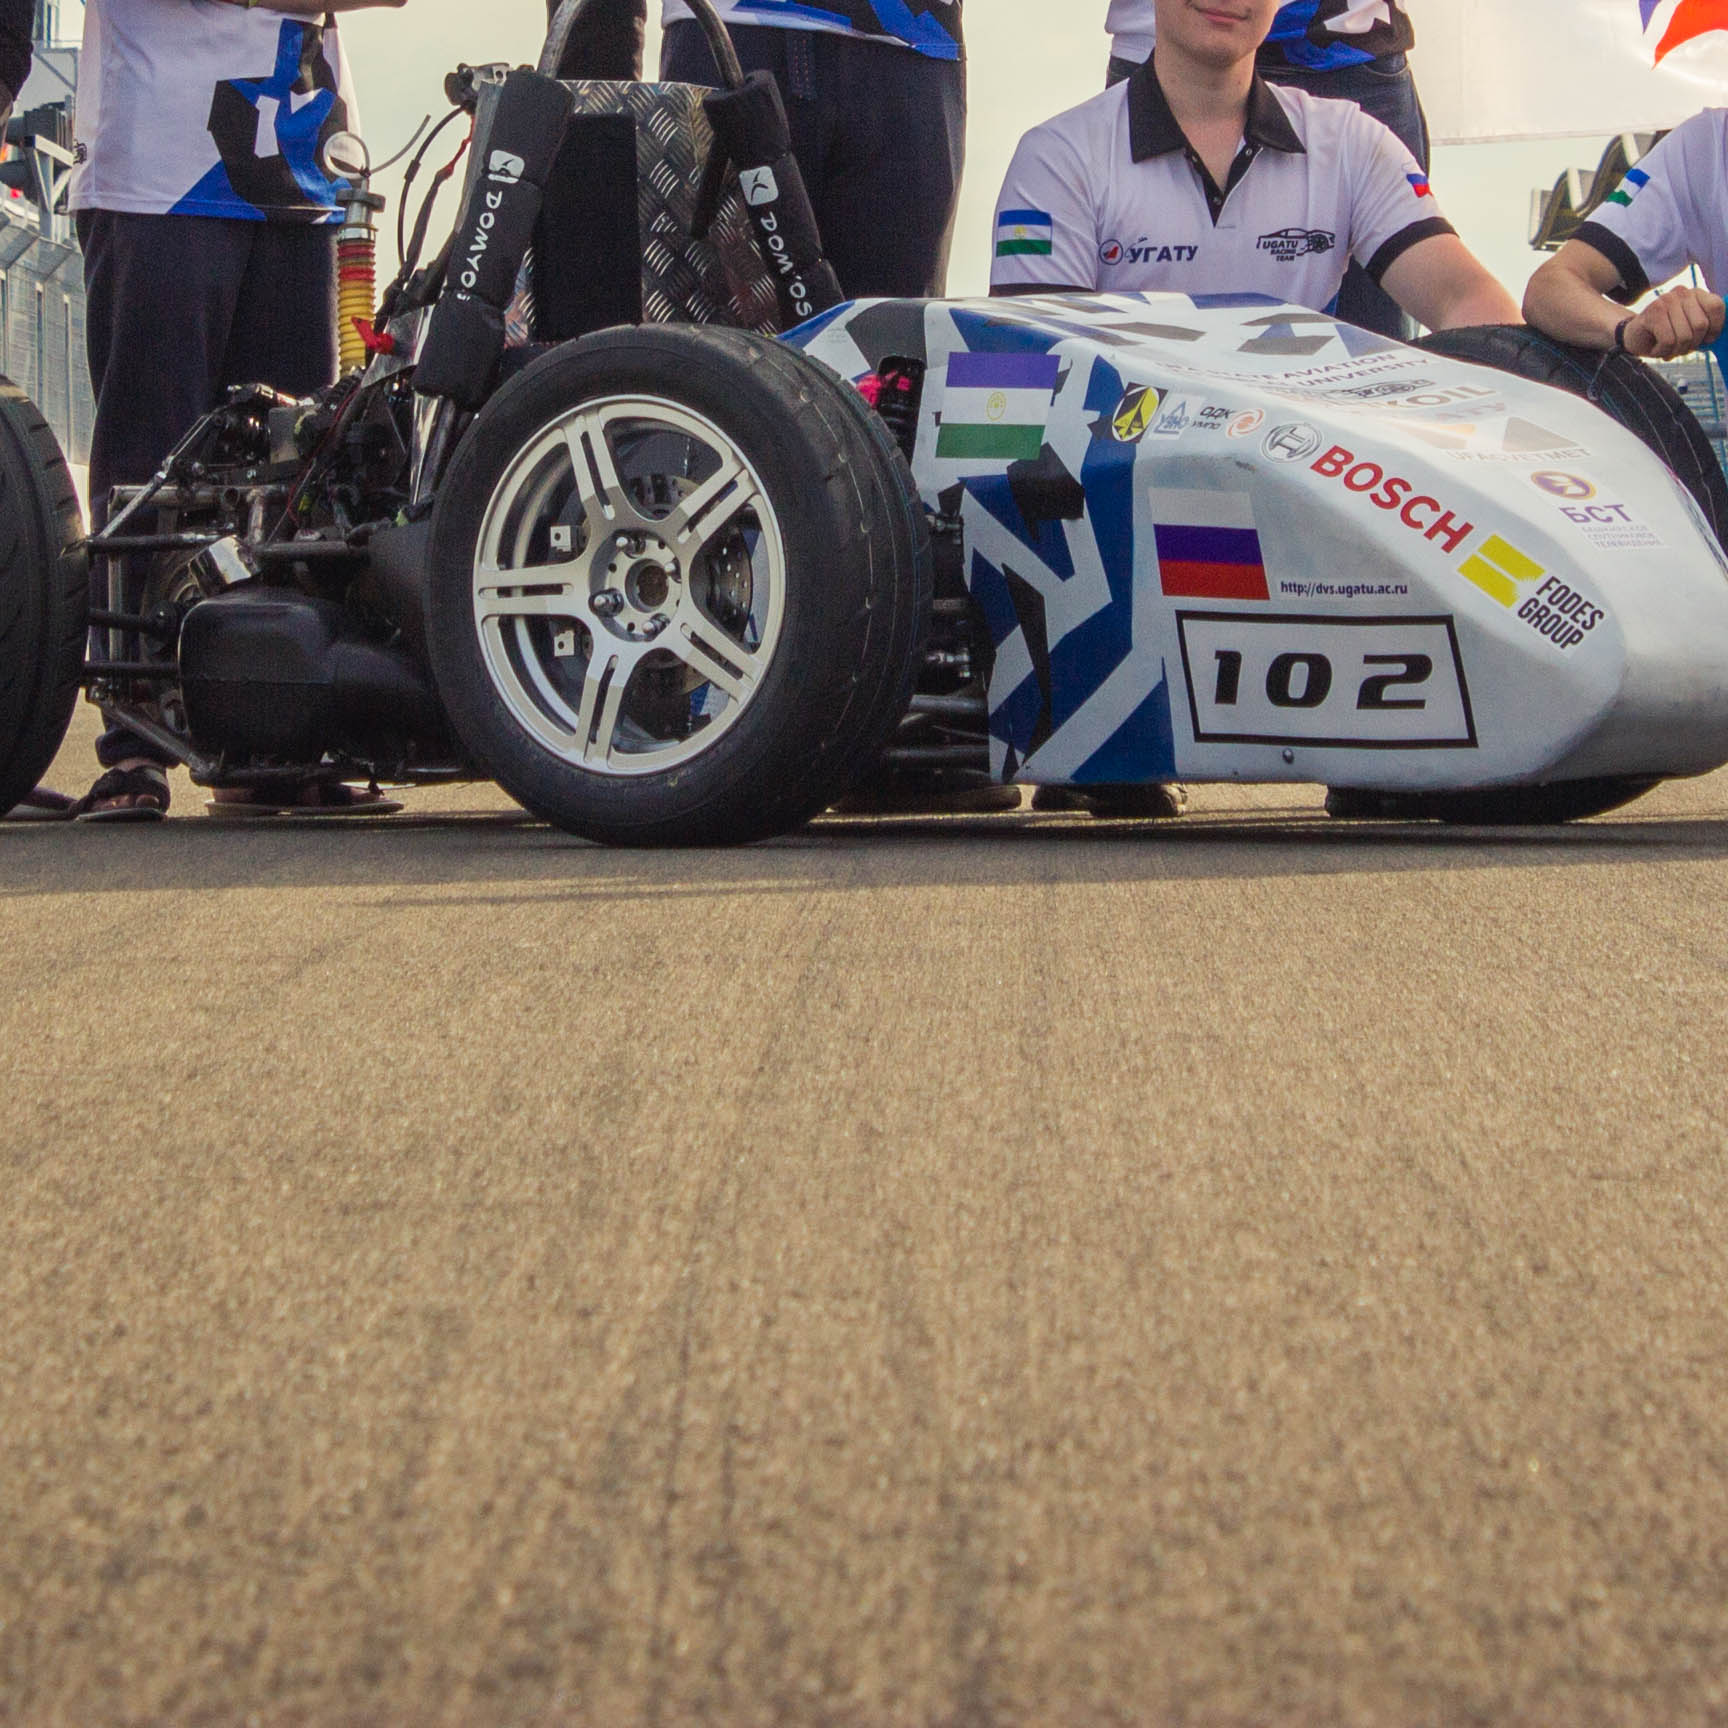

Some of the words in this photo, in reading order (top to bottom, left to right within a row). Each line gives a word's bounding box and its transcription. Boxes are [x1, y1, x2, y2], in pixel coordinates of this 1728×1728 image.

[1128, 245, 1198, 264] УГАТУ
[1262, 240, 1299, 250] UGATU
[760, 211, 813, 317] DOMOS
[1283, 353, 1396, 379] AVIATION
[1299, 358, 1429, 386] UNIVERSITY
[1310, 445, 1474, 554] BOSCH
[1559, 504, 1632, 523] БСТ
[1280, 580, 1408, 599] http://dvs.ugatu.ac.ru
[1535, 576, 1604, 630] FODES
[1517, 598, 1584, 649] GROUP
[1214, 650, 1433, 709] 102
